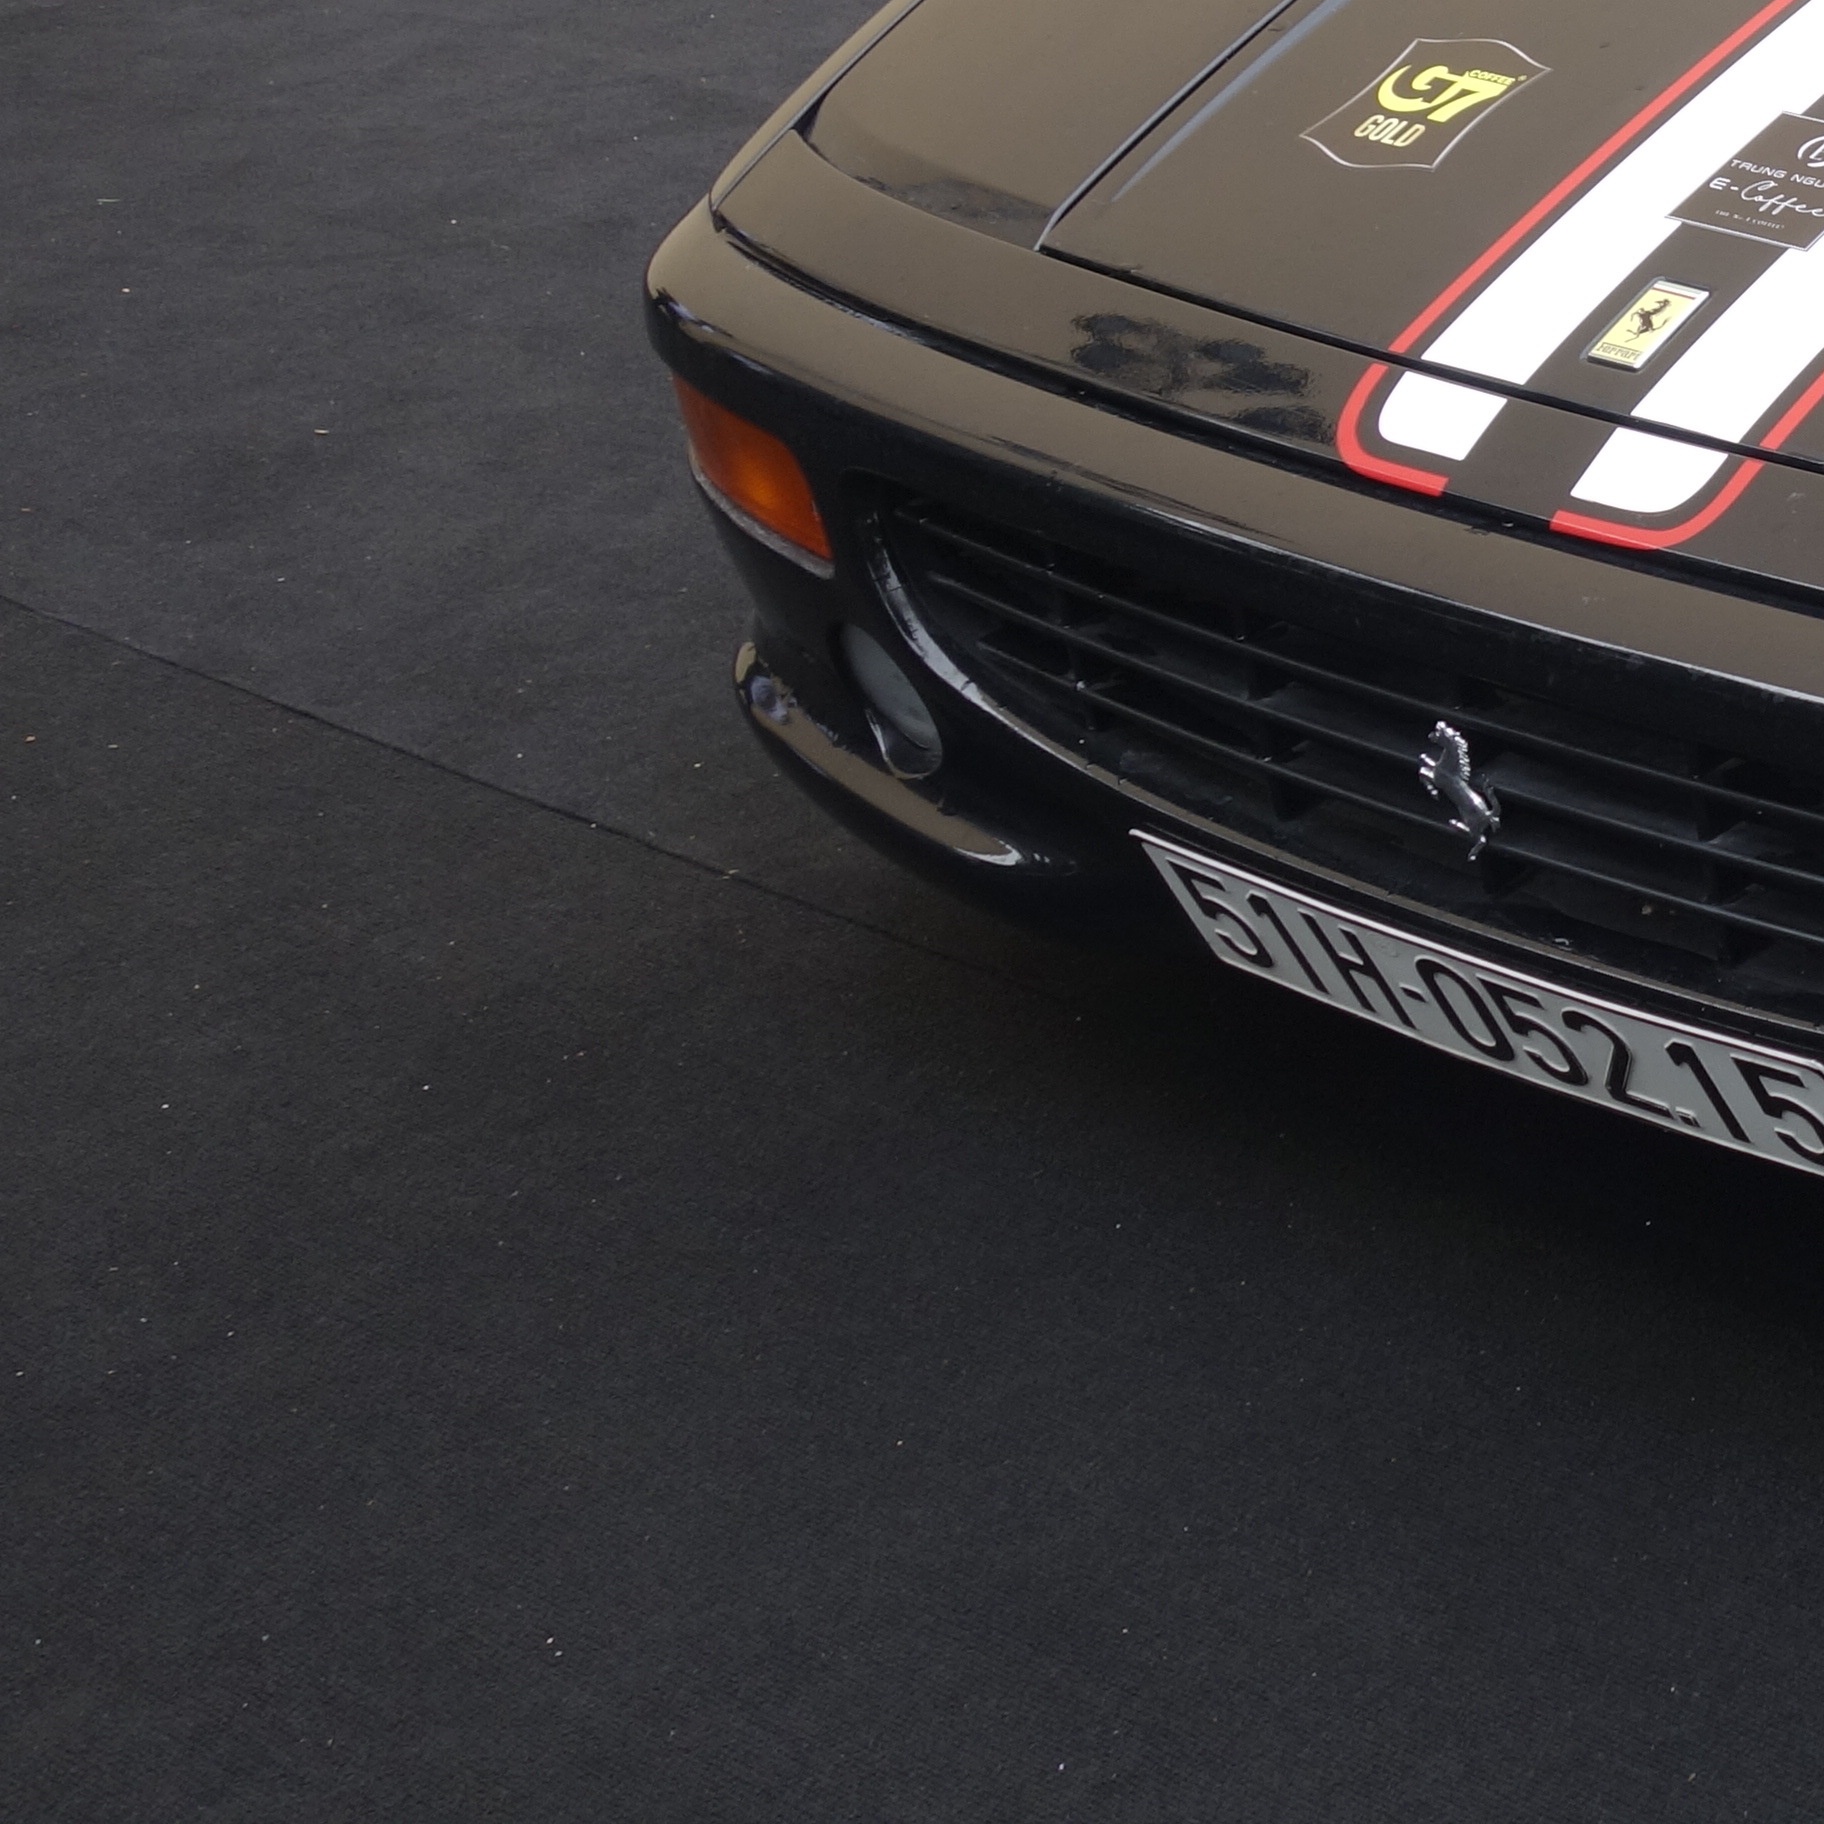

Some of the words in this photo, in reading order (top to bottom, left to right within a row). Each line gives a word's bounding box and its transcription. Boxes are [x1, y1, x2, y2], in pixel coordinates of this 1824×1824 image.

[1466, 68, 1516, 86] COFFEE
[1353, 114, 1426, 148] GOLD
[1730, 159, 1788, 179] TRUNG
